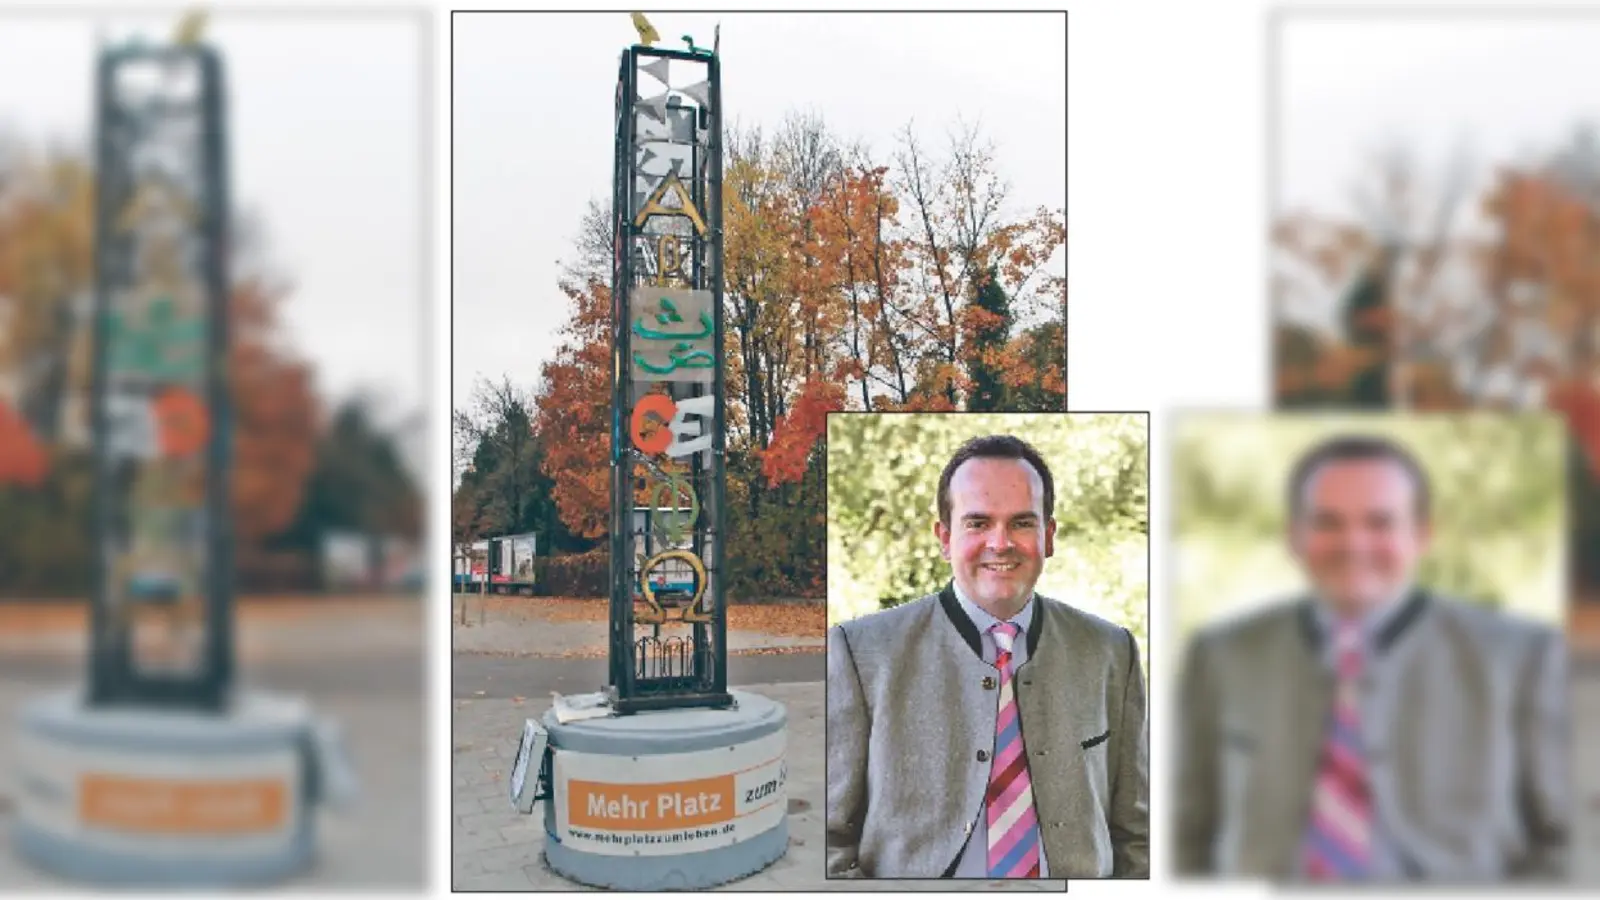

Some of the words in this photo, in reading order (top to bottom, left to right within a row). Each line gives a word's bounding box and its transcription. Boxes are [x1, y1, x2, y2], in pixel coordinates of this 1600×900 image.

[587, 792, 649, 819] Mehr
[657, 792, 722, 818] Platz
[744, 780, 777, 803] zum
